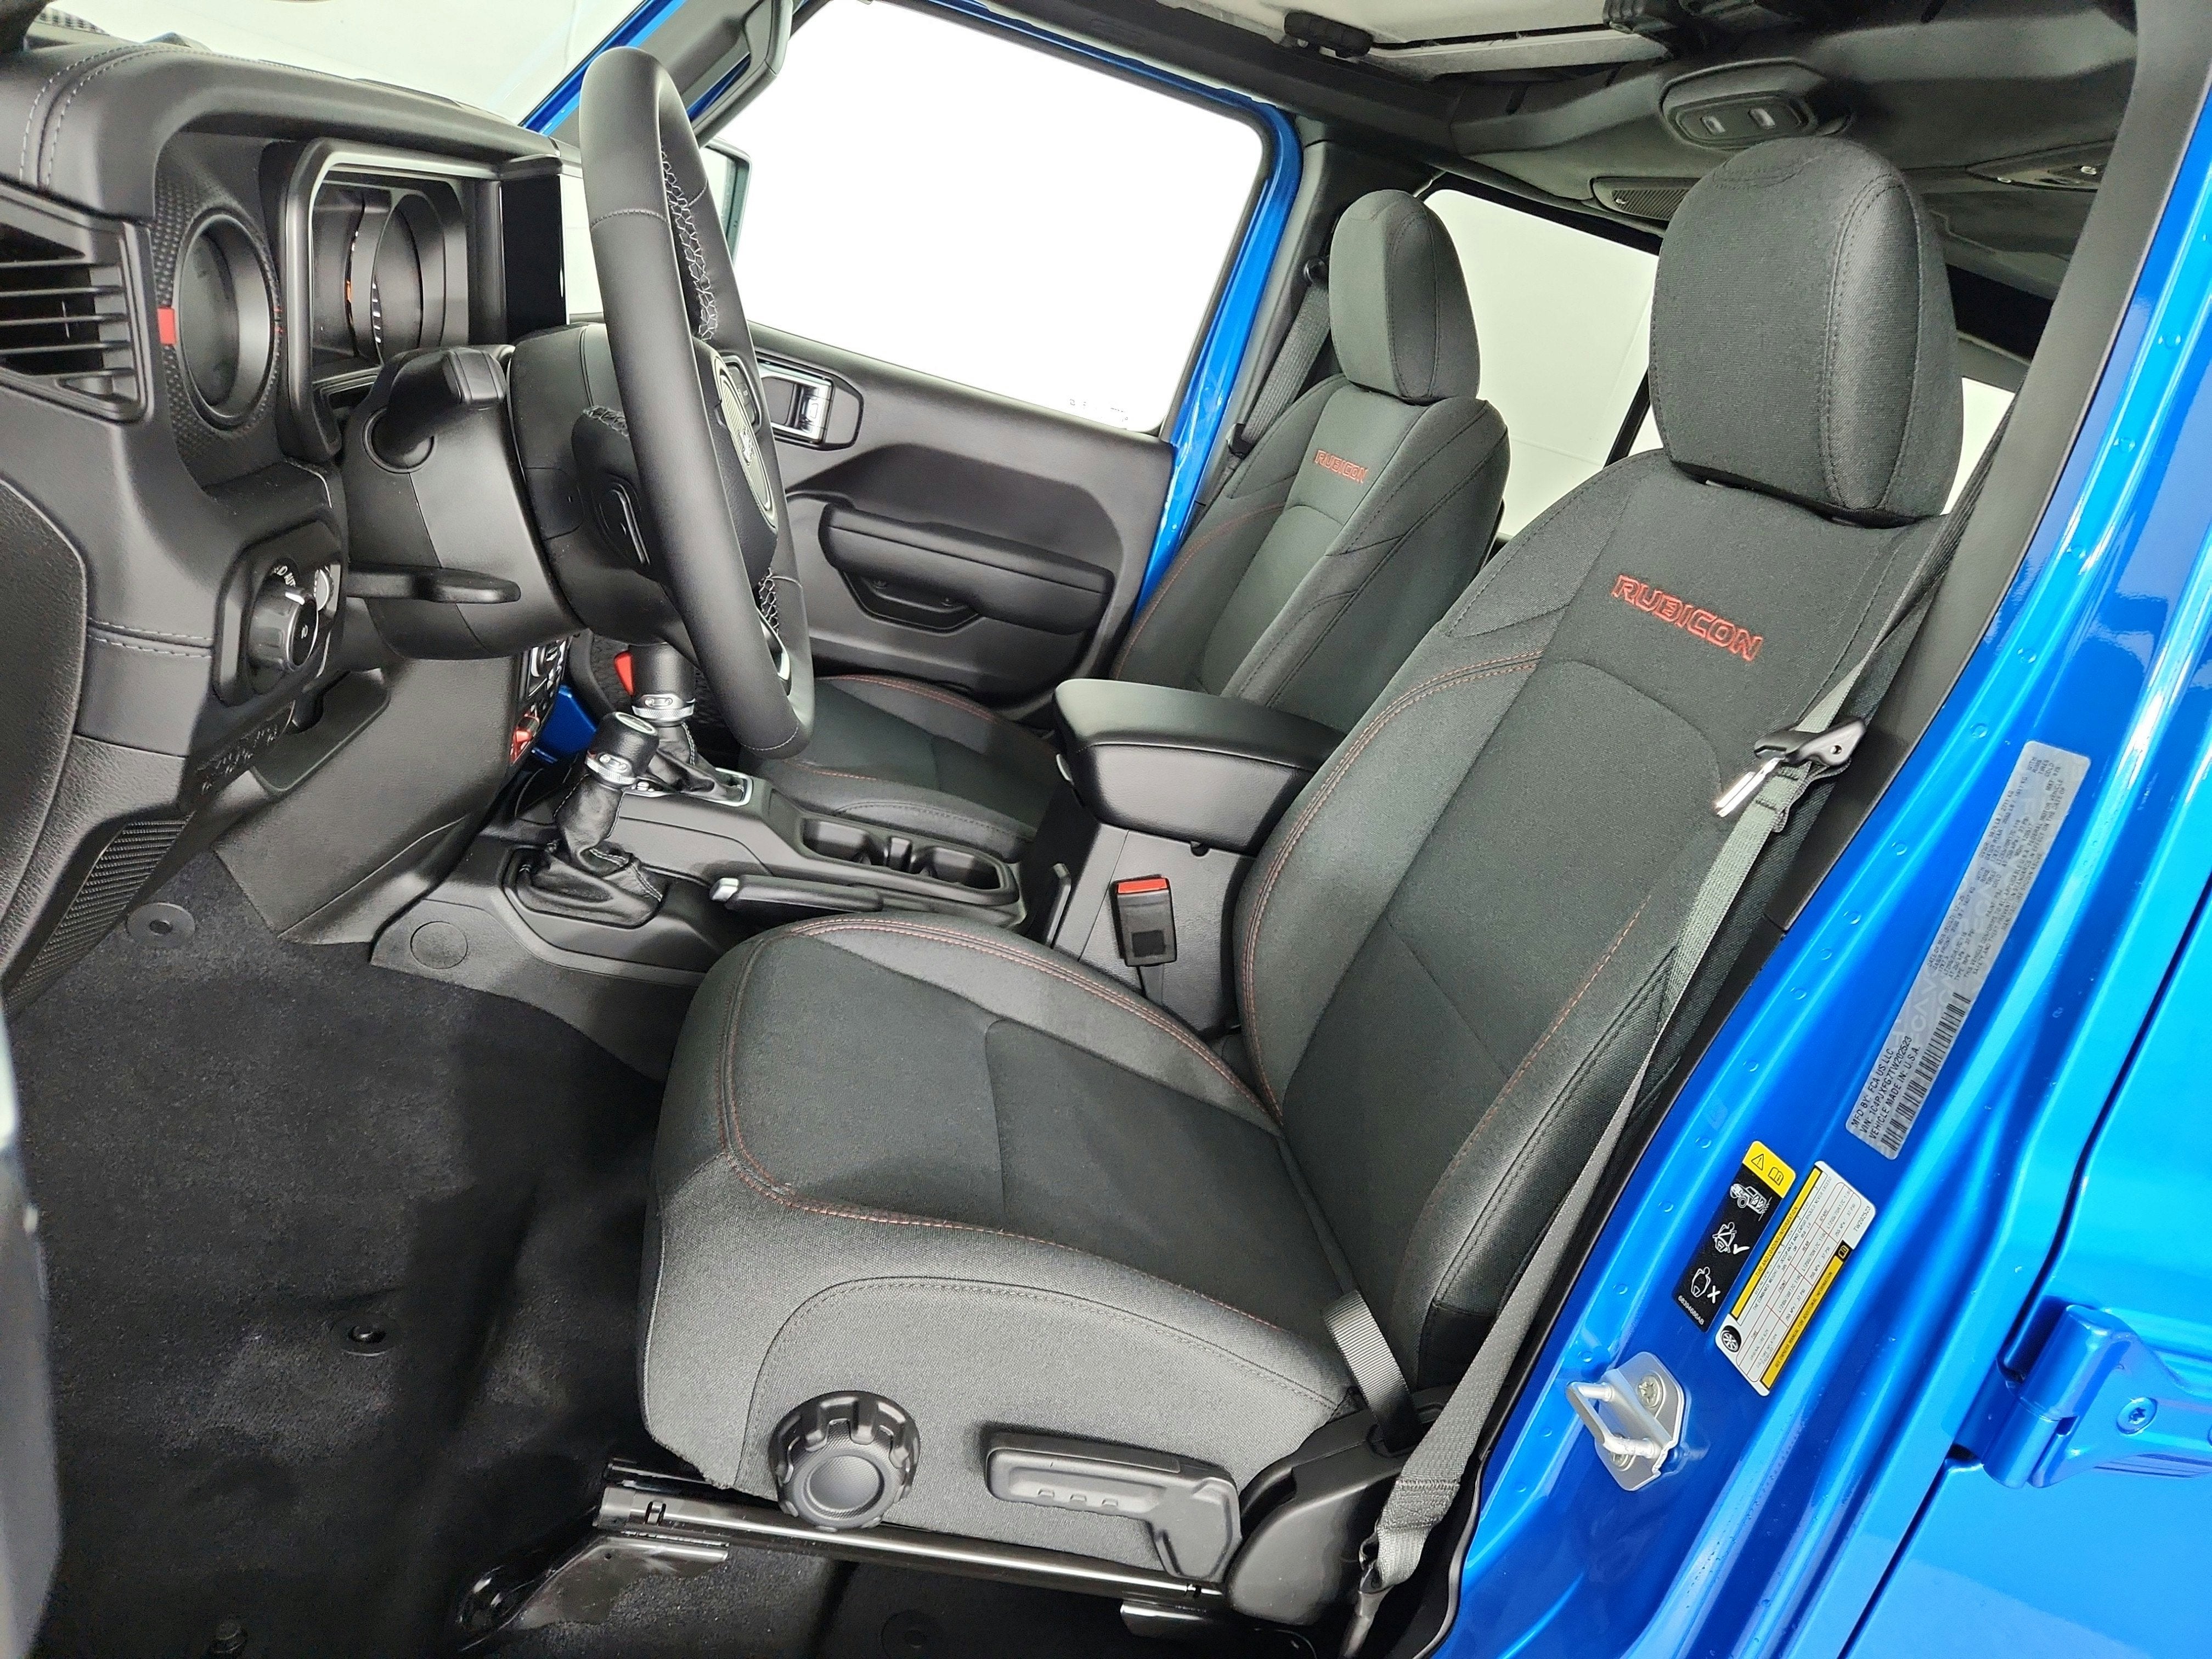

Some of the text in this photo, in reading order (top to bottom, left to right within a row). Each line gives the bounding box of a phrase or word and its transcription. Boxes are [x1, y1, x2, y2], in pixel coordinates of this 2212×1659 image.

[1315, 449, 1368, 484] RUBICON
[284, 572, 296, 587] AUT
[1611, 574, 1763, 662] RUBICON
[1850, 1047, 1894, 1128] MFD BY: FCA US LLC
[1859, 1035, 1912, 1135] VIN: 1C4PJXFG7TW202523
[1869, 1107, 1889, 1141] VEHICLE
[1884, 1082, 1901, 1107] MADE
[1896, 1069, 1908, 1083] IN:
[1755, 1265, 1763, 1277] TIRE
[1760, 1255, 1769, 1267] AND
[1767, 1235, 1780, 1257] LOADING
[1778, 1205, 1798, 1237] INFORMATION
[1853, 1205, 1871, 1232] TW202523
